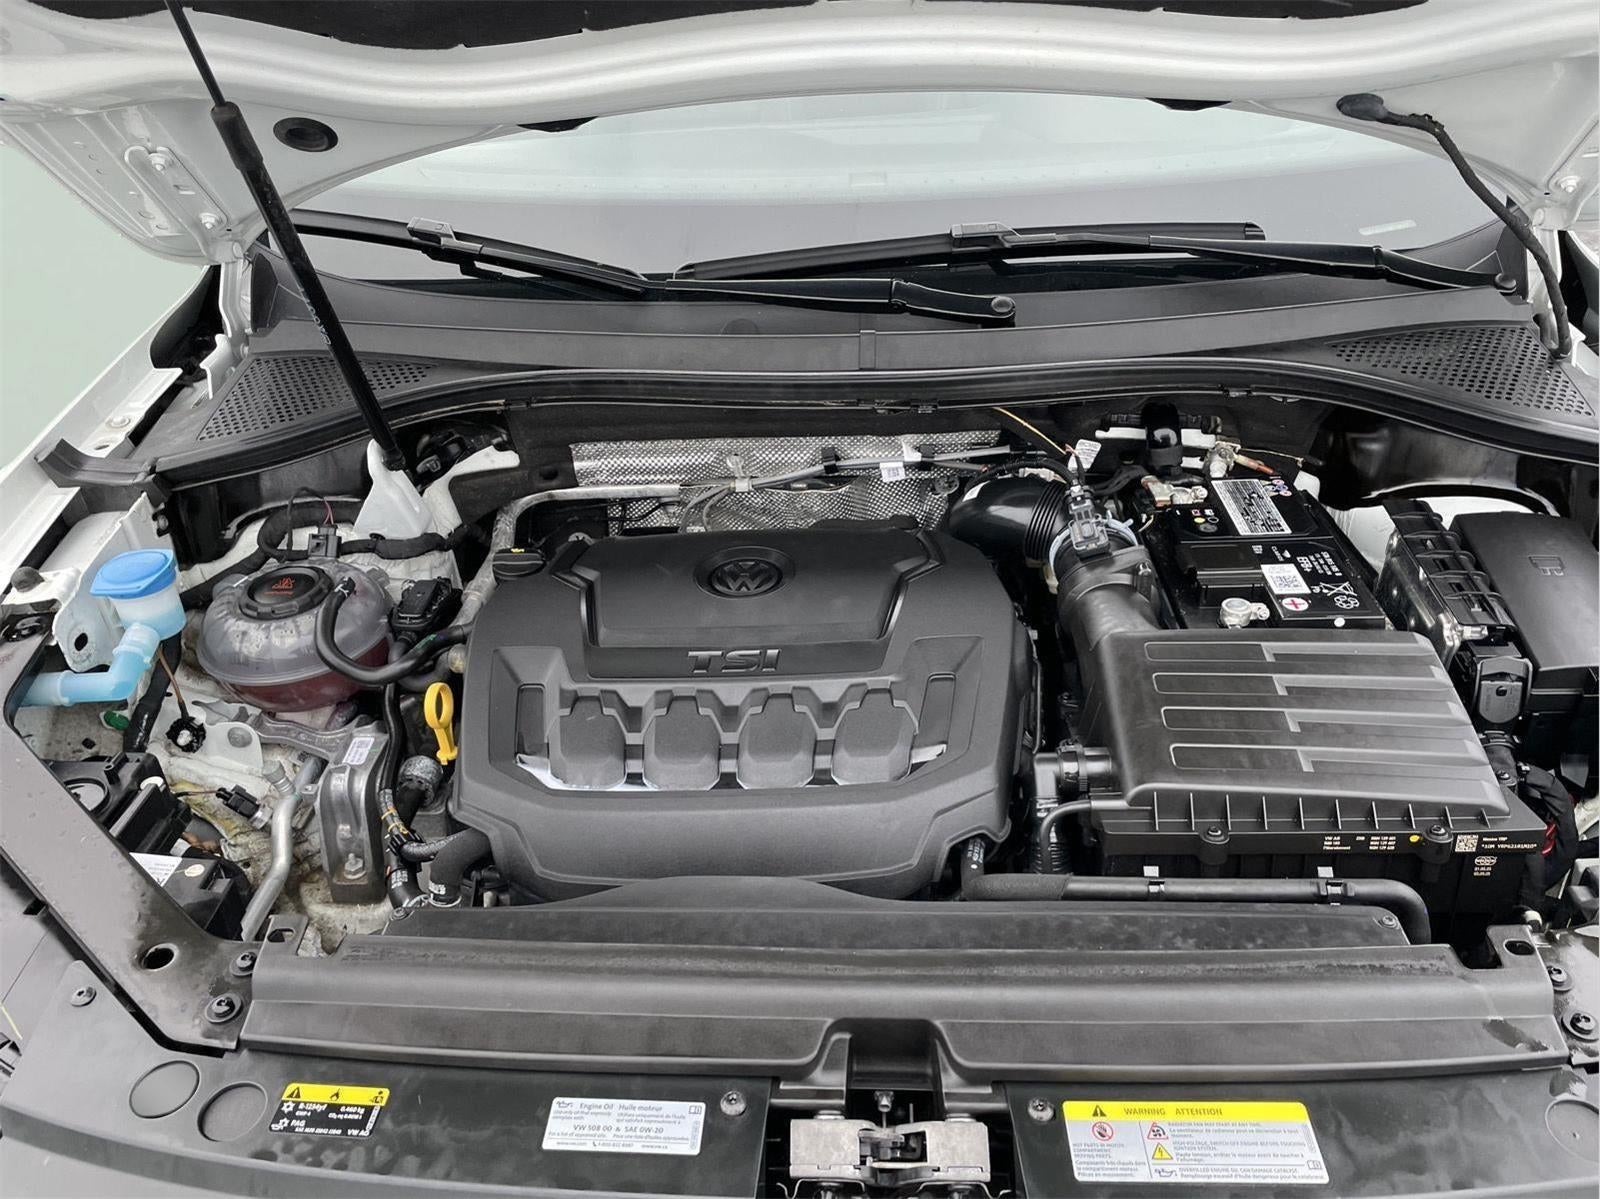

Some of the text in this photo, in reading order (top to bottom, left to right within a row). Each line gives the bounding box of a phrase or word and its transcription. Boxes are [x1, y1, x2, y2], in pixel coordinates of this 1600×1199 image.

[688, 650, 781, 673] TSI
[298, 1103, 328, 1112] R-1234yf
[580, 1103, 602, 1111] Engine
[1123, 1108, 1223, 1116] WARNING ATTENTION
